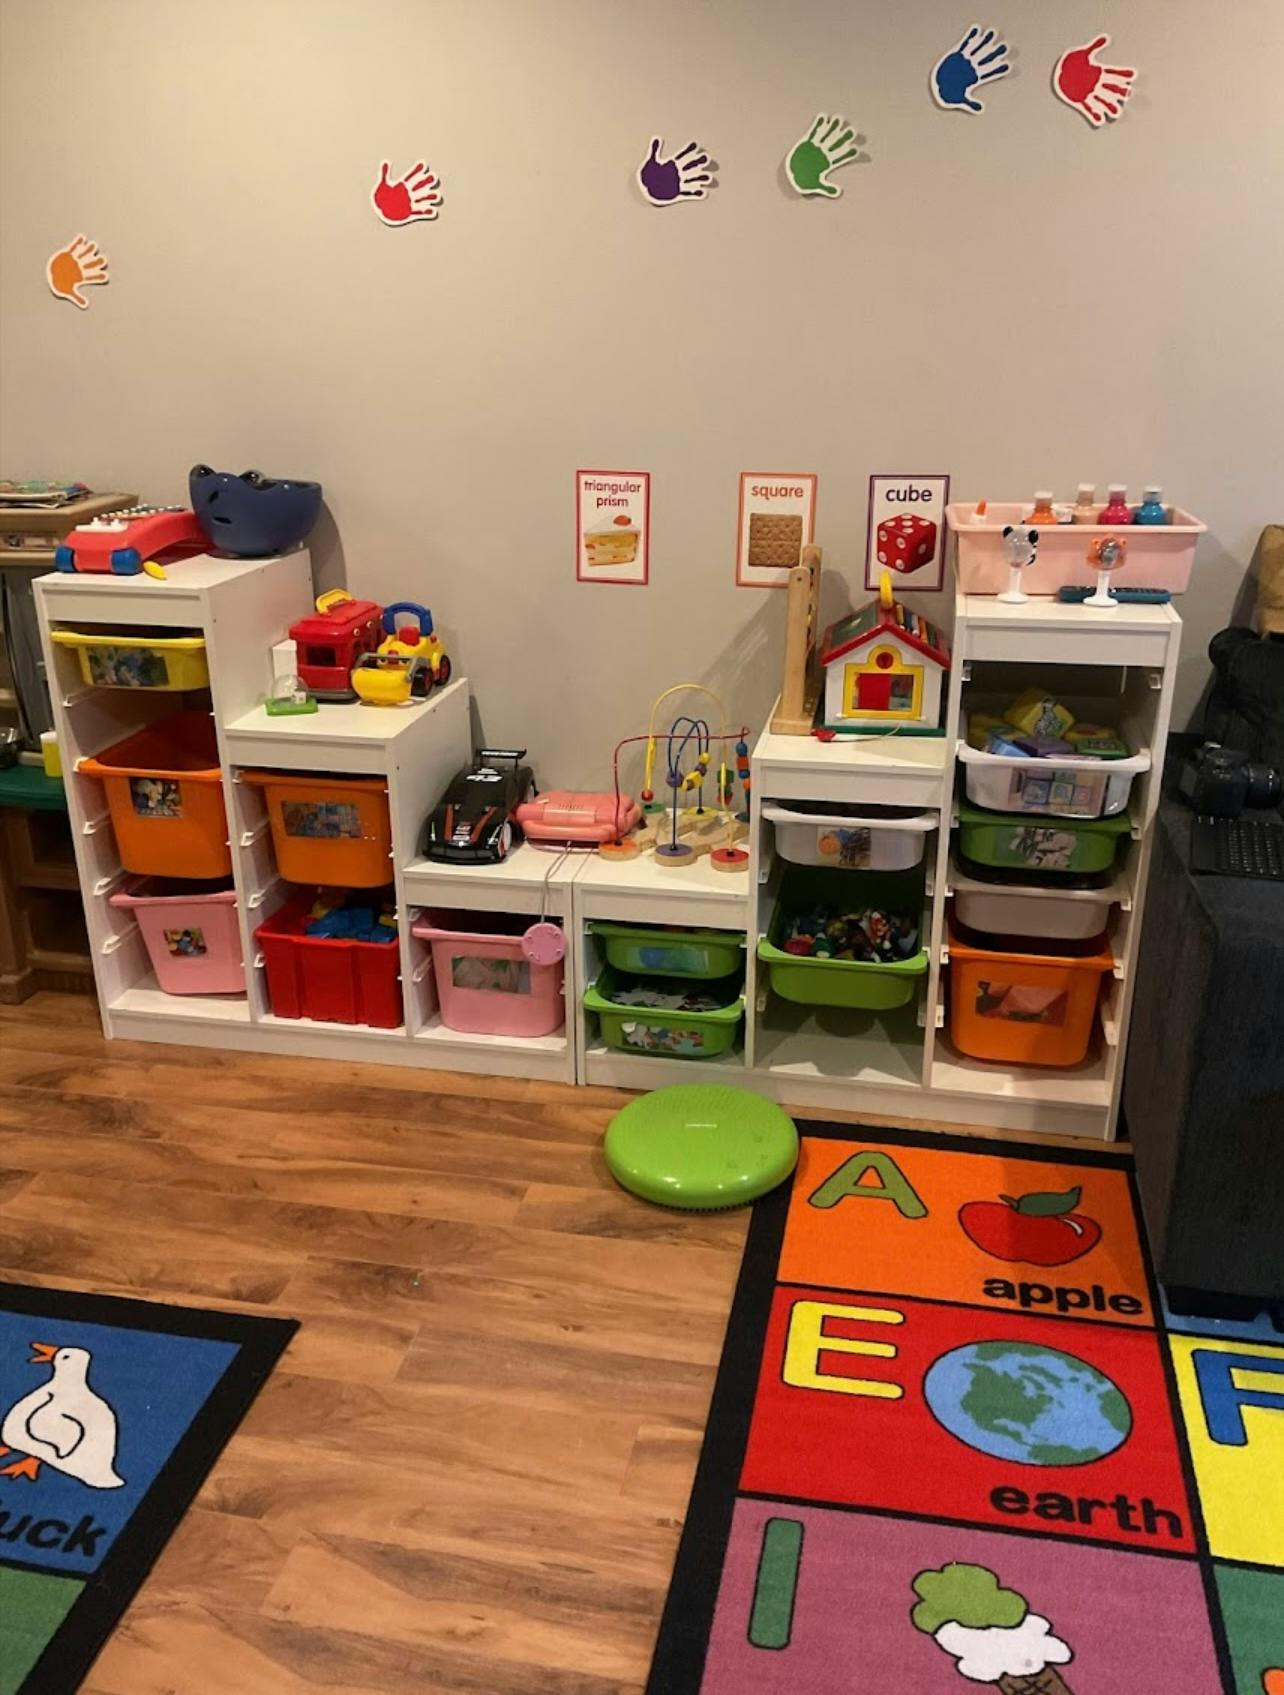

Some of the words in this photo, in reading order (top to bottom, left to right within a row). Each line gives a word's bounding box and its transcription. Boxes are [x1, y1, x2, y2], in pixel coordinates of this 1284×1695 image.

[584, 480, 641, 495] triangular
[596, 495, 629, 509] prism
[751, 485, 804, 500] square
[885, 484, 933, 502] cube
[807, 1150, 929, 1220] A
[982, 1276, 1144, 1316] apple
[780, 1299, 906, 1400] E
[1190, 1348, 1284, 1447] F
[0, 1511, 107, 1557] uck
[989, 1484, 1184, 1539] earth
[746, 1516, 806, 1651] I
